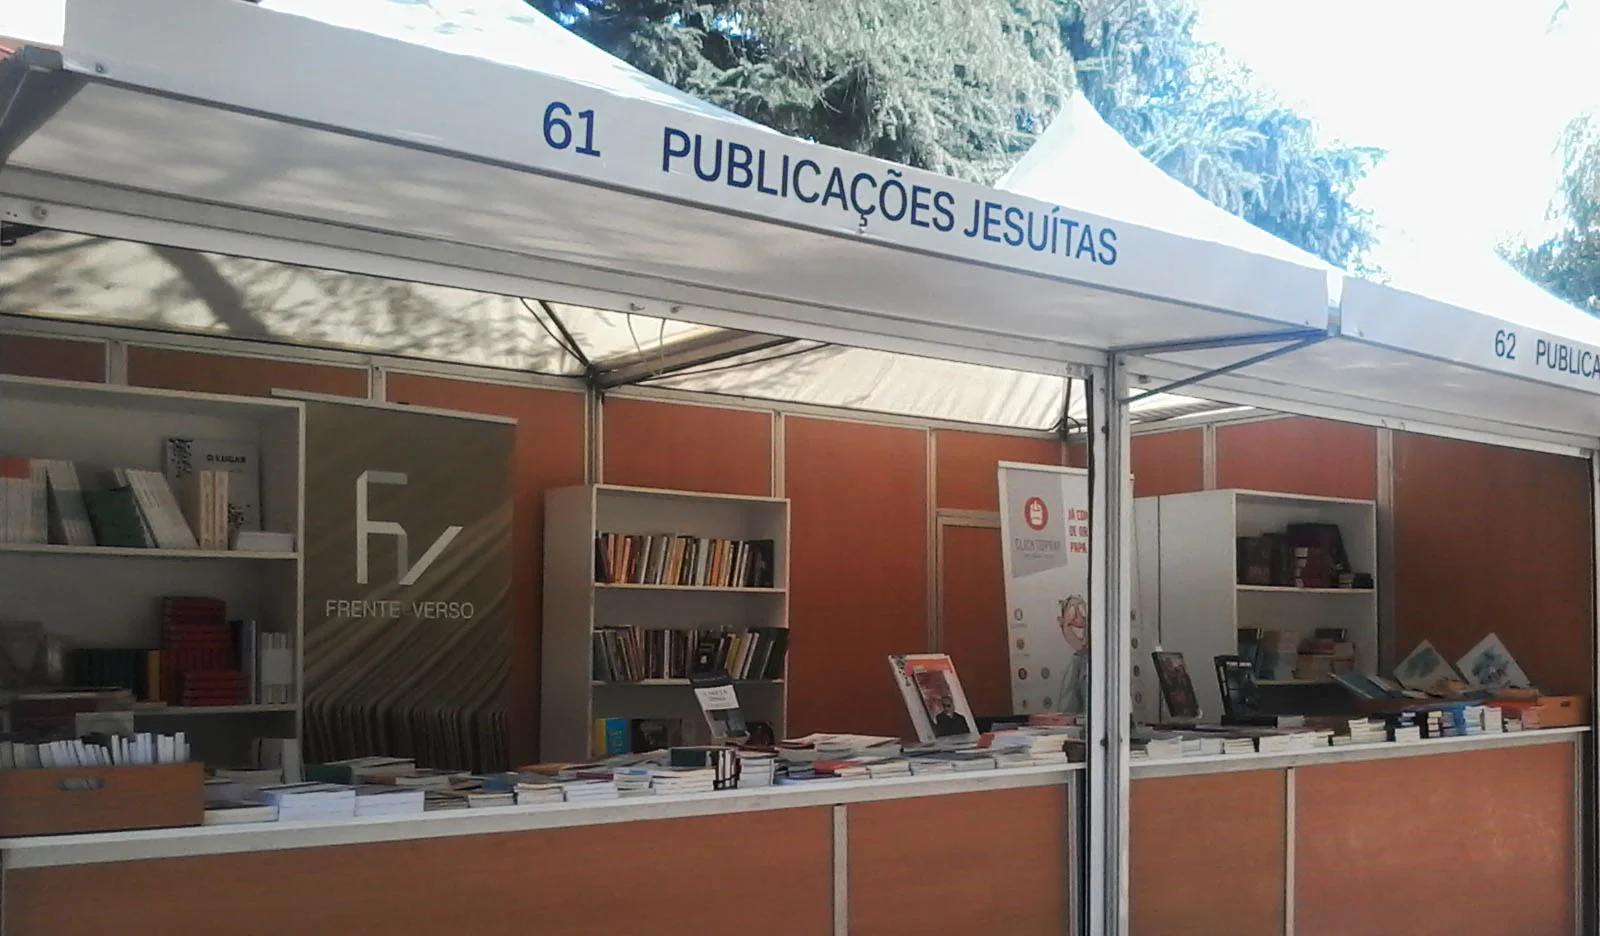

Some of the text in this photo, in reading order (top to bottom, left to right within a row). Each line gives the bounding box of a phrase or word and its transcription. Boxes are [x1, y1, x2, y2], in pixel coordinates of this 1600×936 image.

[541, 101, 1119, 266] 61 PUBLICAÇÕES JESUÍTAS
[1494, 329, 1517, 360] 62
[325, 600, 400, 619] FRENTE
[412, 602, 475, 619] VERSO
